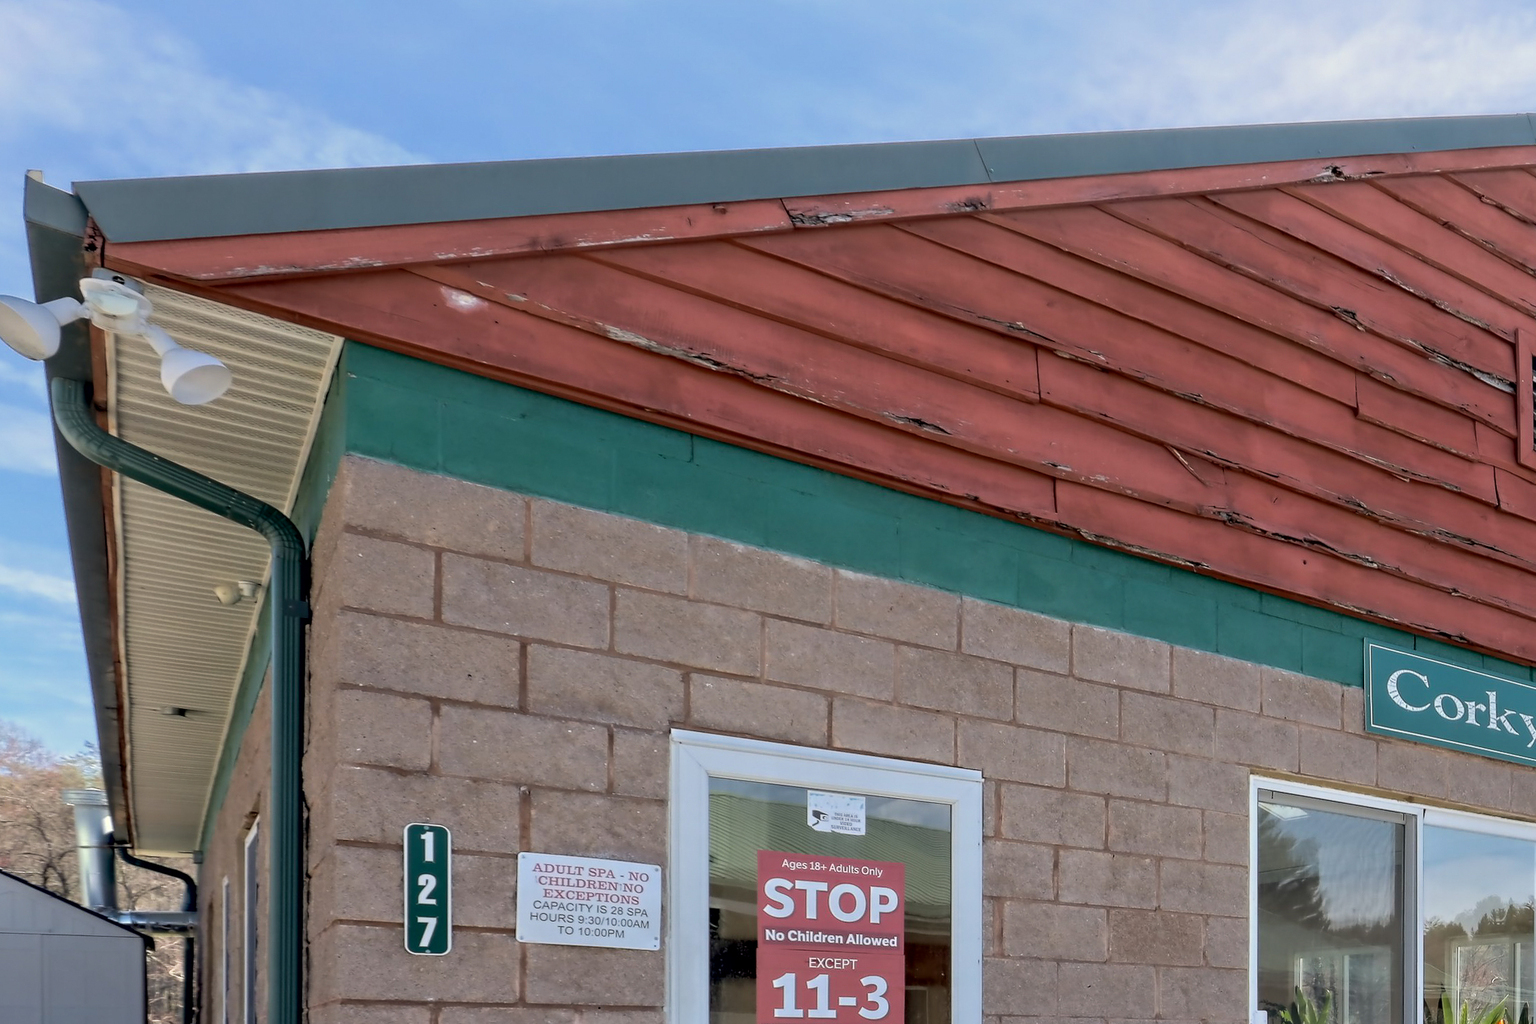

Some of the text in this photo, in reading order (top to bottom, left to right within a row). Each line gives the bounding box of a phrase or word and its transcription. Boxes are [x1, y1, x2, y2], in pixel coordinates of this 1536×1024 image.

[532, 863, 584, 876] ADULT
[588, 868, 615, 879] SPA
[628, 871, 649, 882] NO
[782, 859, 883, 878] Ages 18+ Adults Only
[538, 876, 644, 894] CHILDREN NO
[543, 888, 640, 905] EXCEPTIONS
[763, 877, 899, 924] STOP
[533, 900, 648, 918] CAPACITY IS 28 SPA
[530, 912, 649, 929] HOURS 9:30/10:00AM
[557, 925, 625, 938] TO 10:00PM
[765, 929, 898, 947] No Children Allowed
[808, 957, 858, 970] EXCEPT
[772, 973, 889, 1020] 11-3
